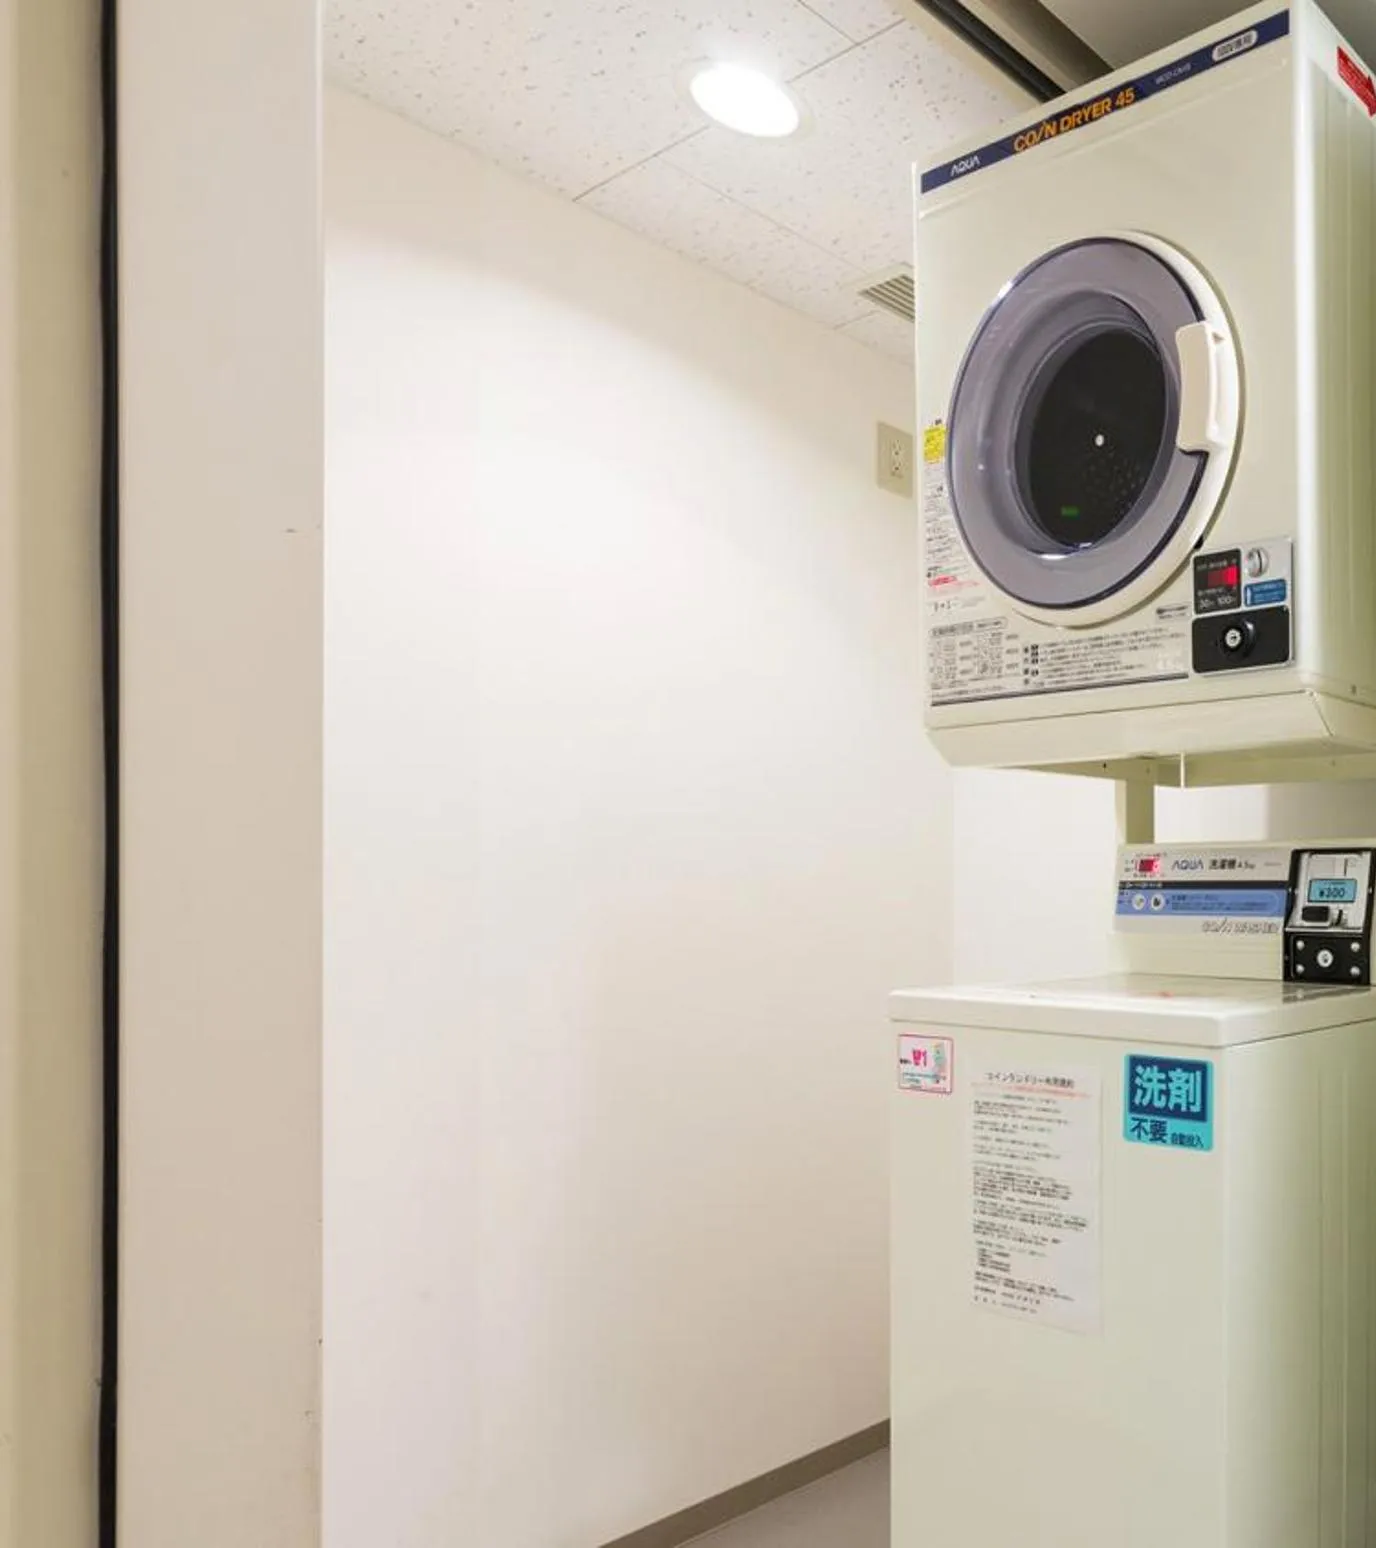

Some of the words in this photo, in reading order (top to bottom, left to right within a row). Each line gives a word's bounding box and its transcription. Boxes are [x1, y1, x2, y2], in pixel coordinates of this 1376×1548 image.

[951, 155, 980, 176] AQUA
[1060, 98, 1112, 131] DRYER
[1116, 87, 1135, 107] 45
[1172, 859, 1204, 871] AQUA
[1134, 1065, 1201, 1112] 洗剤
[1130, 1117, 1167, 1143] 不要
